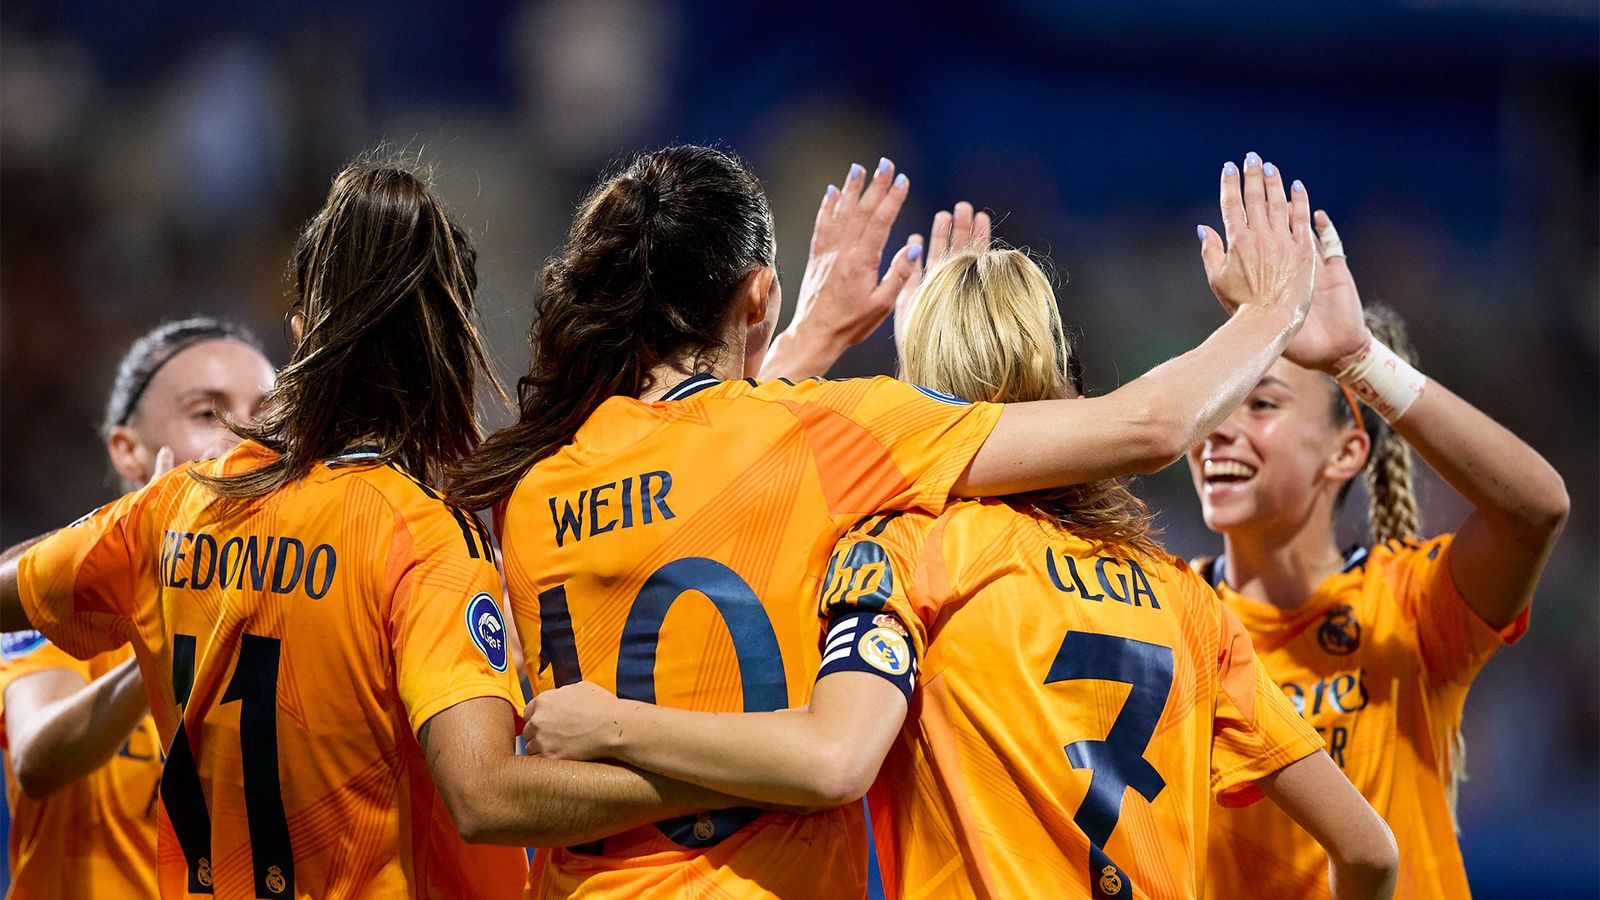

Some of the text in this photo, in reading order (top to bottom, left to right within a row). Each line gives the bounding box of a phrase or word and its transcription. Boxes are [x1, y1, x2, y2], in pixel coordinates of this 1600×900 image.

[548, 470, 676, 548] WEIR
[160, 530, 337, 600] REDONDO
[820, 545, 886, 616] hp
[160, 634, 295, 900] 11
[1044, 630, 1173, 900] 7
